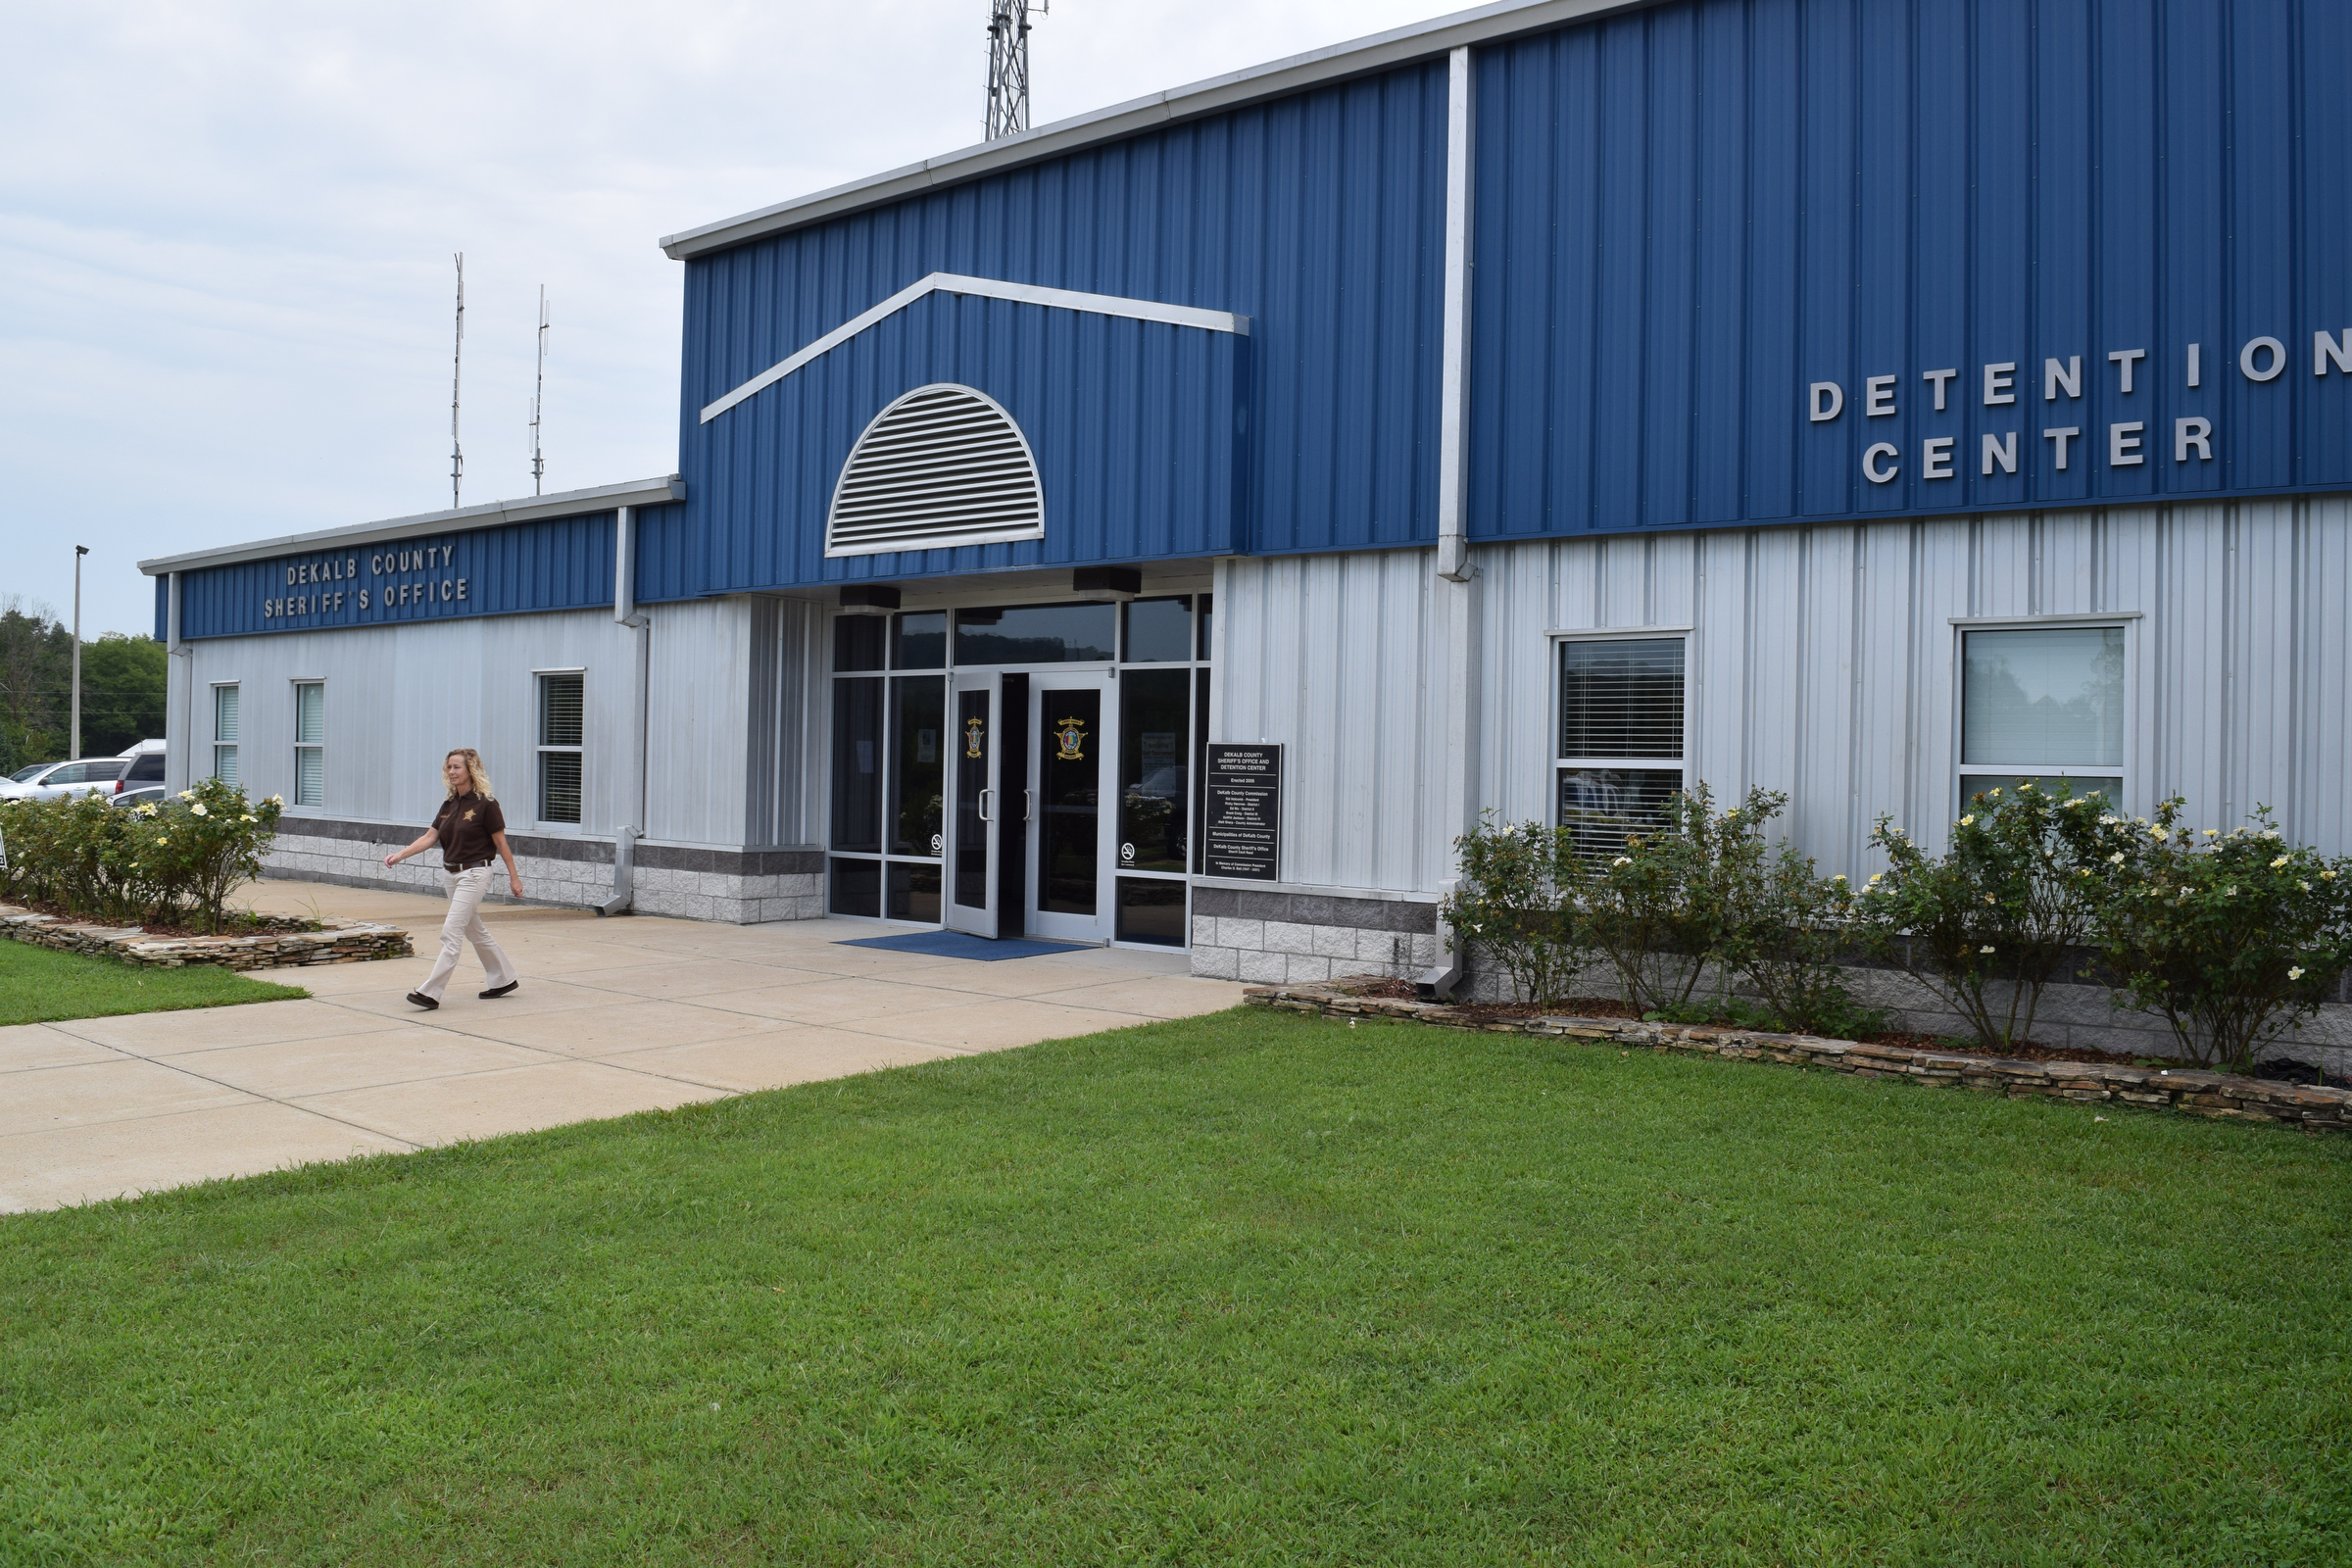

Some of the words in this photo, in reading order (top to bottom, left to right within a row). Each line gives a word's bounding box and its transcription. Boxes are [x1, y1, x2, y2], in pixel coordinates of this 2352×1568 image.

[1810, 327, 2352, 422] DETENTION
[1862, 416, 2213, 483] CENTER
[287, 559, 356, 585] DEKALB
[371, 545, 454, 575] COUNTY
[265, 589, 369, 617] SHERIFF'S
[384, 578, 467, 607] OFFICE
